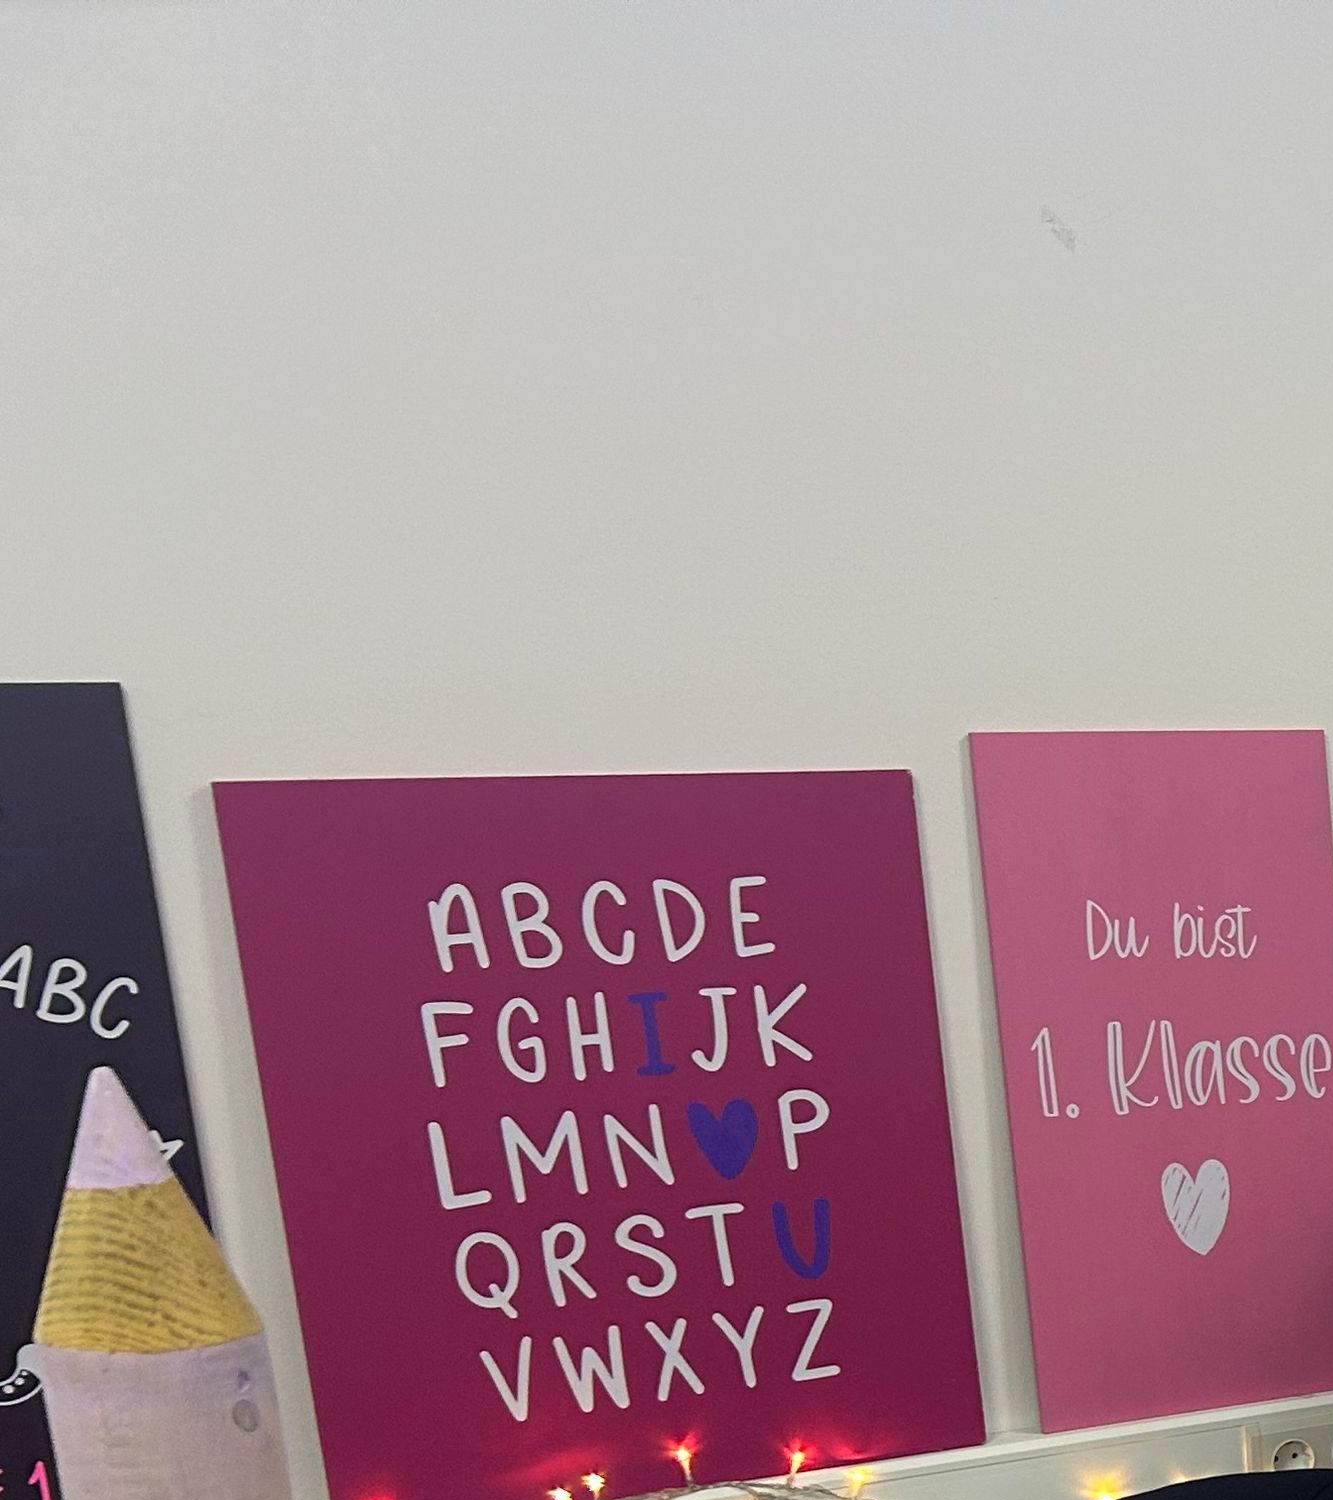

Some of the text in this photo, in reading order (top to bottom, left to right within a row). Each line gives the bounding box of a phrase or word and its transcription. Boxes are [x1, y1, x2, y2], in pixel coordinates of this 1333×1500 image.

[1085, 899, 1258, 960] Du bist
[1031, 1020, 1333, 1118] 1. Klasse
